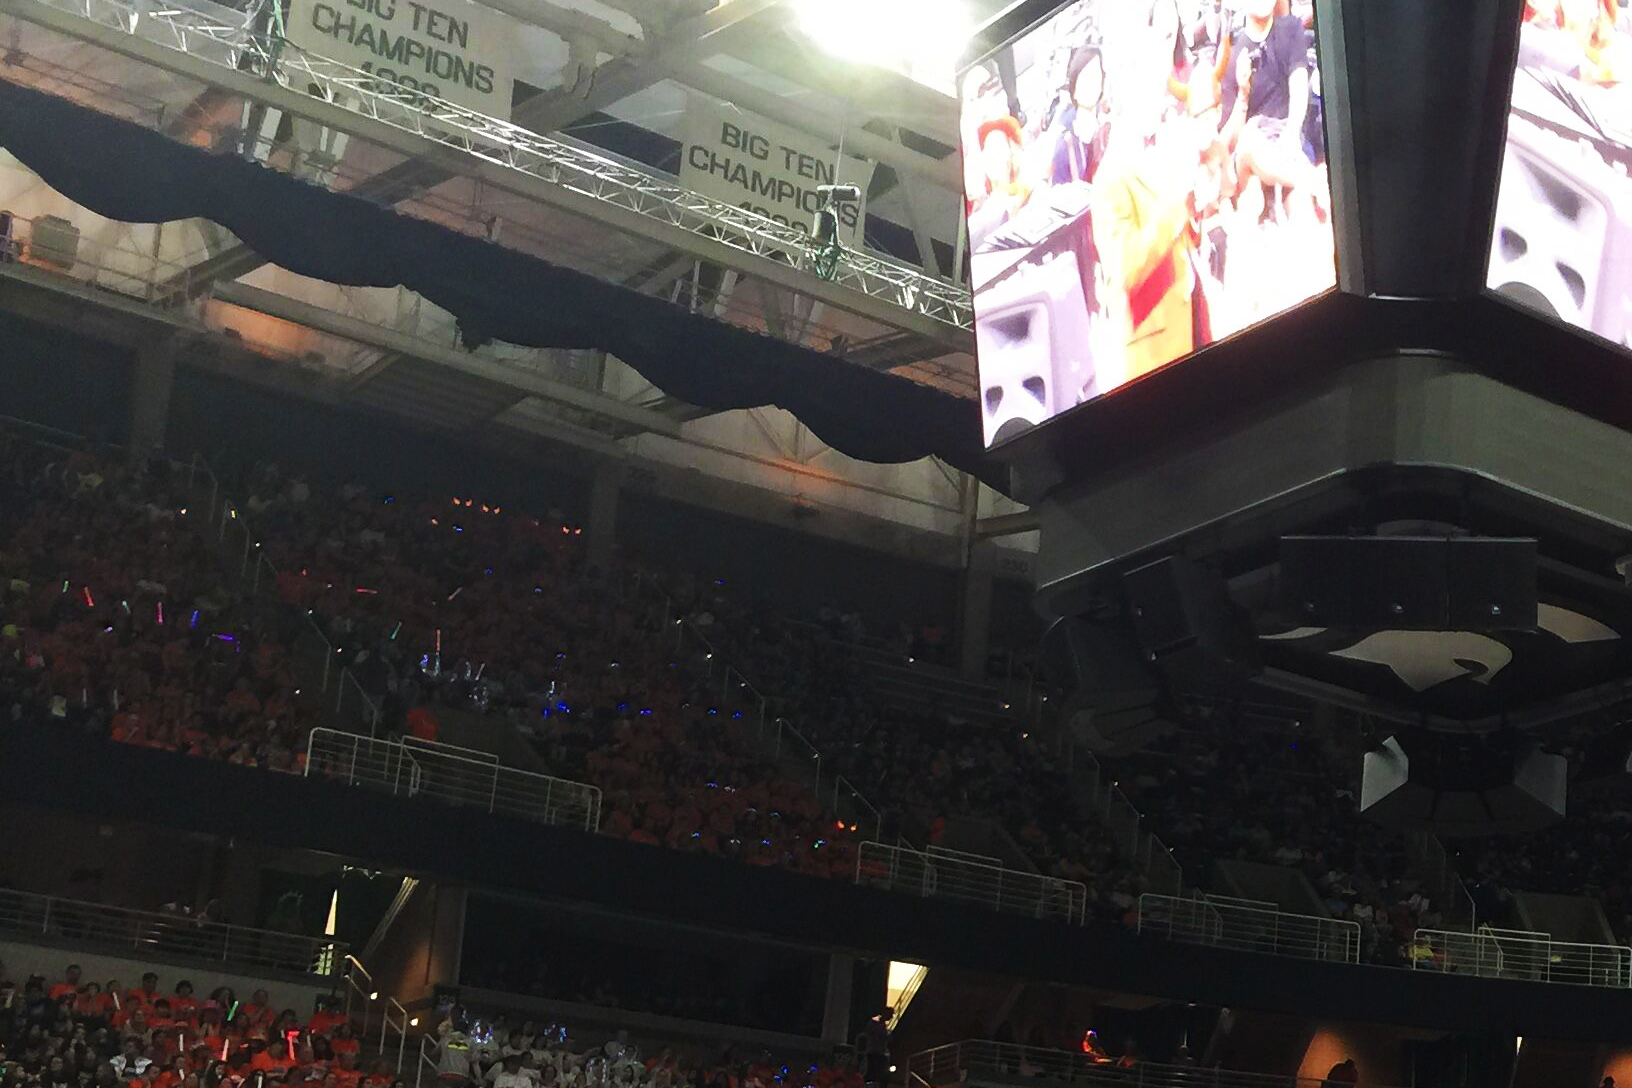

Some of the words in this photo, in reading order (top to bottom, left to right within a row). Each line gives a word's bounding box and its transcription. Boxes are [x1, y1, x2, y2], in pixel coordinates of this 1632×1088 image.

[312, 3, 495, 94] CHAMPIONS
[408, 2, 469, 49] TEN
[689, 145, 859, 228] CHAMPIOS
[721, 122, 770, 160] BIG
[779, 146, 835, 185] TEN
